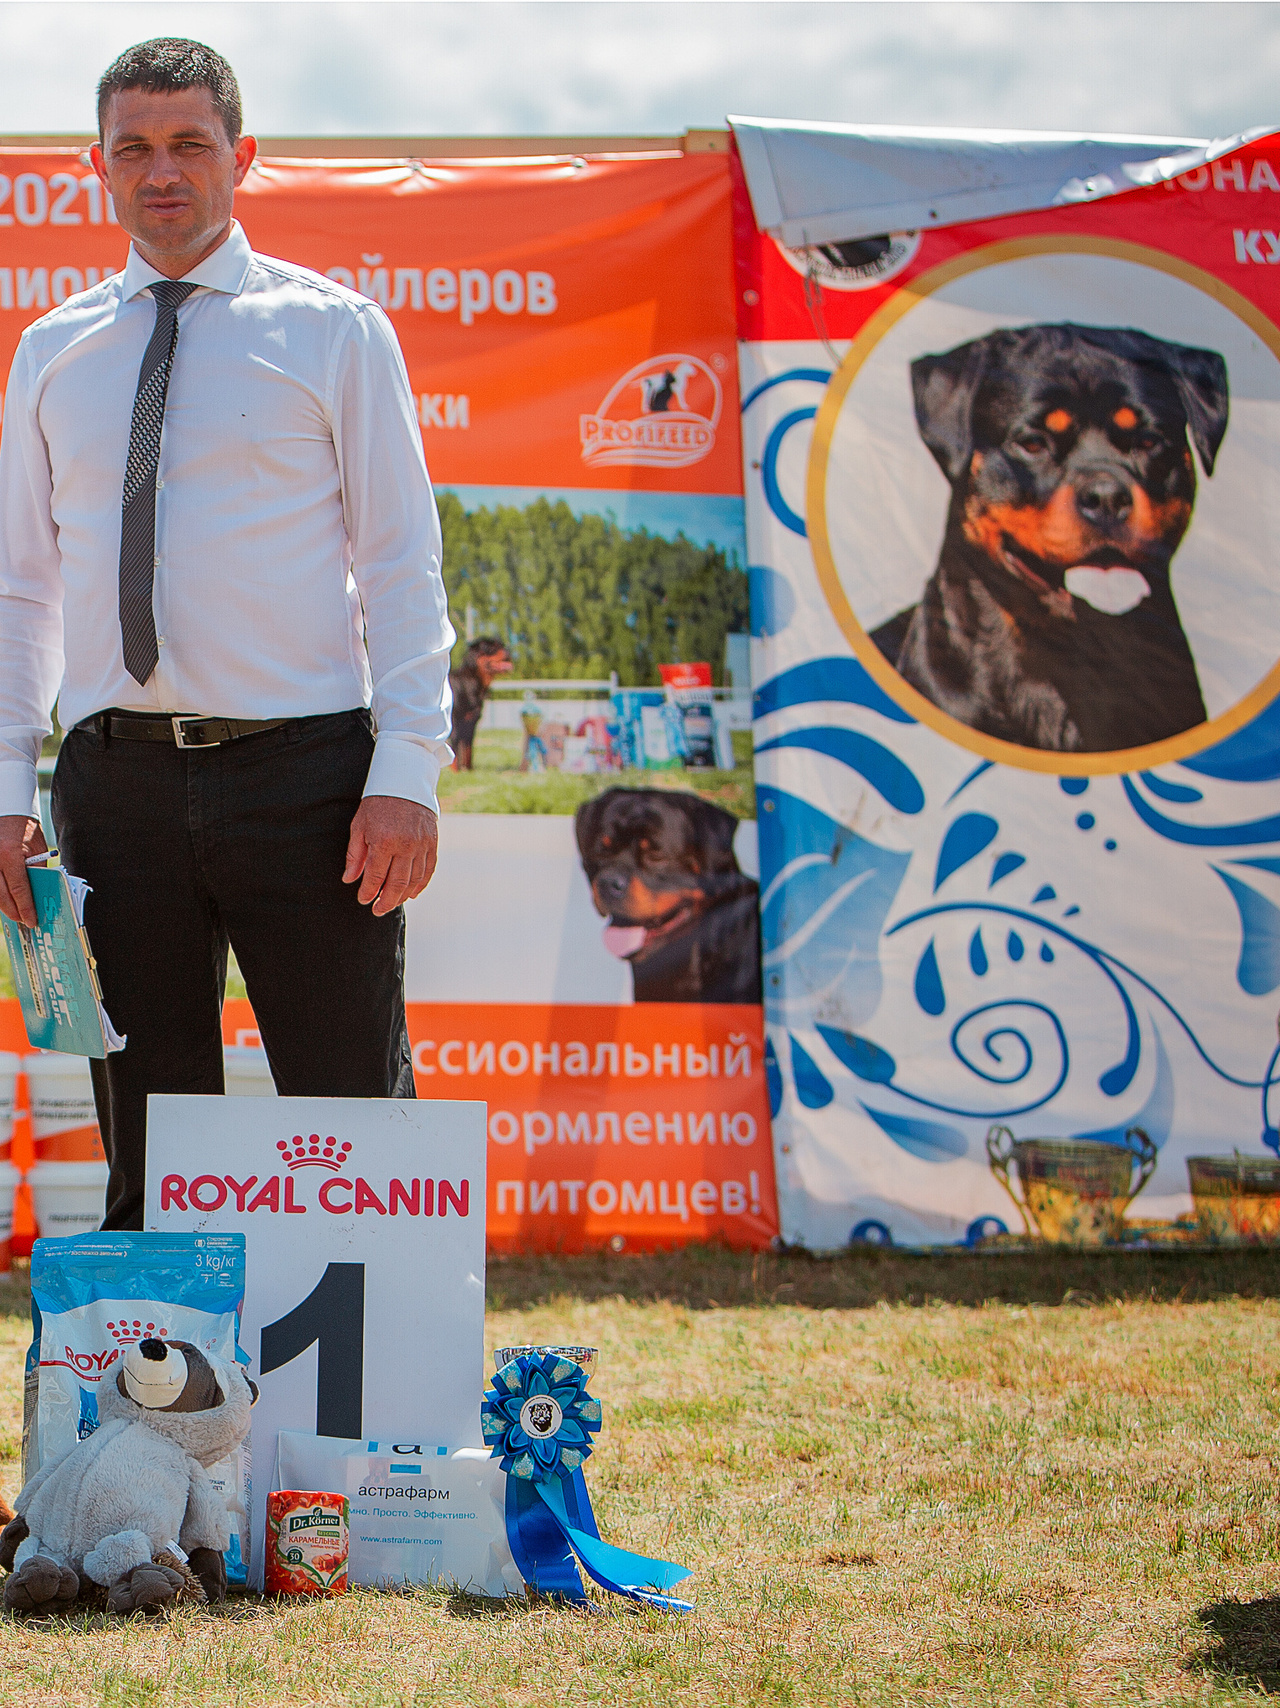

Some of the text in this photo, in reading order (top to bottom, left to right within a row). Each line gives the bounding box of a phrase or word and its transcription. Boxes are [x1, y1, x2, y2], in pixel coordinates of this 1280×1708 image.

[1163, 159, 1280, 193] ОНА
[1232, 228, 1280, 264] КУ
[326, 253, 557, 326] йлеров
[412, 394, 470, 429] ки
[413, 1032, 752, 1078] ссиональный
[488, 1110, 757, 1156] ормлению
[161, 1174, 470, 1218] ROYAL CANIN
[496, 1170, 762, 1223] питомцев!
[195, 1254, 202, 1267] 3
[65, 1345, 126, 1371] ROYA
[260, 1262, 365, 1440] 1
[358, 1485, 450, 1501] астрафарм
[292, 1515, 339, 1529] Dr. Körner
[348, 1507, 479, 1520] мно. Просто. Эффективно.
[288, 1536, 340, 1546] КАРАМЕЛЬНЫЕ
[289, 1552, 300, 1561] 30
[360, 1535, 443, 1546] www.astrafarm.com
